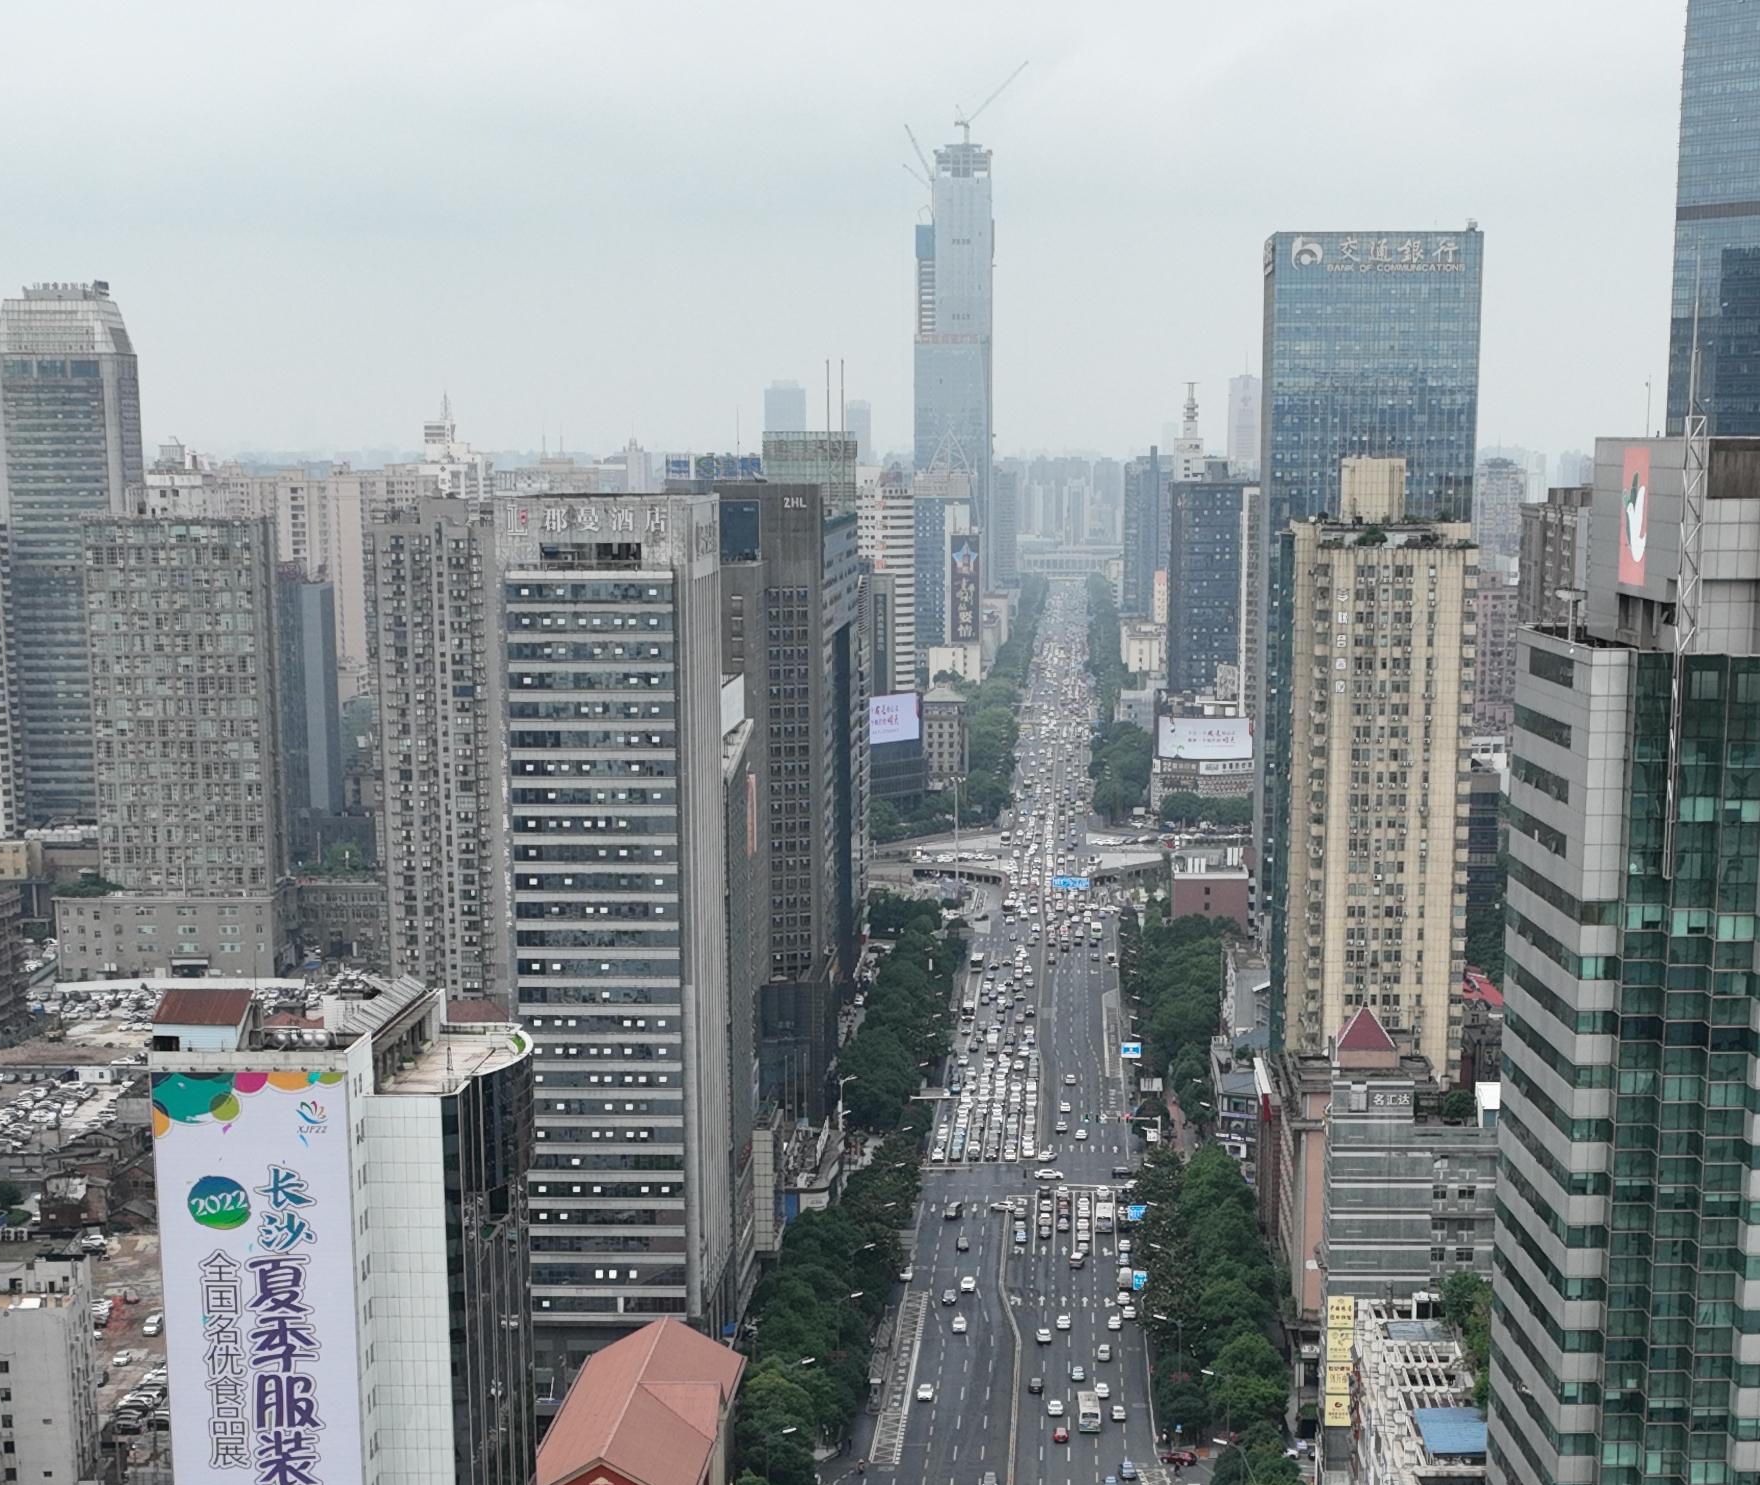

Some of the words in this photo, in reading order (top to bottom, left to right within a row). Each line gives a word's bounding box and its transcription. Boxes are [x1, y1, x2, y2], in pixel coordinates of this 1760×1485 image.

[1340, 236, 1459, 262] 交通銀行
[1373, 1093, 1410, 1105] 名汇达
[191, 1189, 249, 1217] 2022
[201, 1251, 251, 1468] 全国名优食品展
